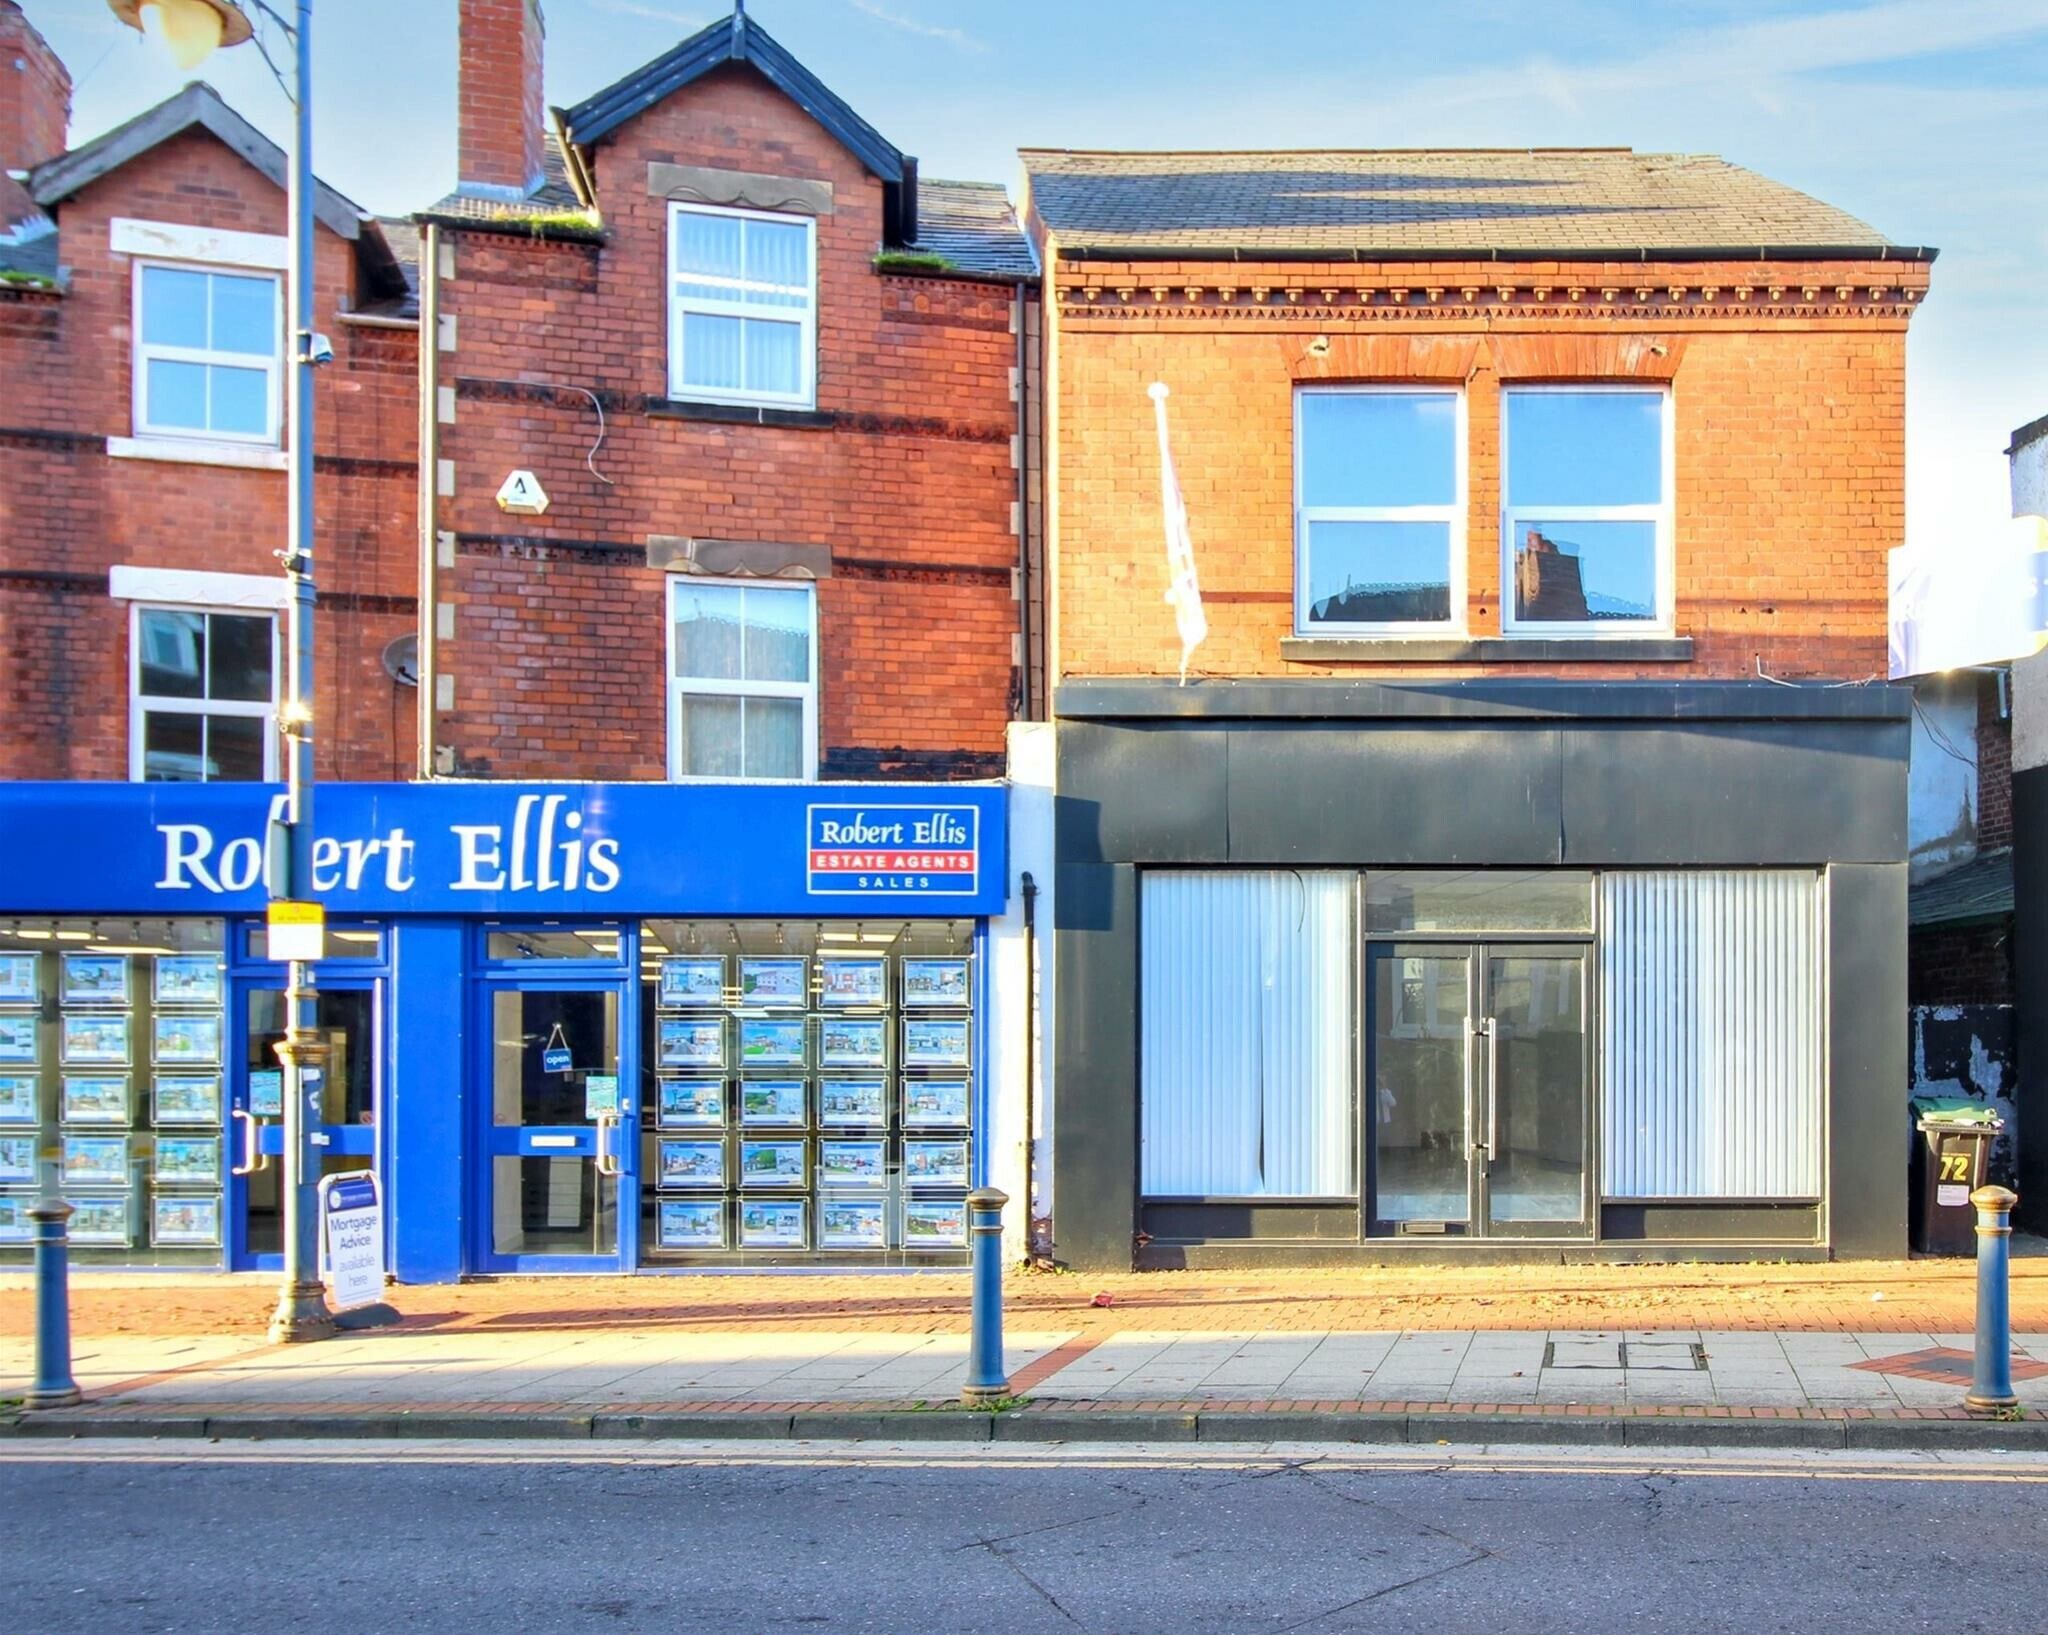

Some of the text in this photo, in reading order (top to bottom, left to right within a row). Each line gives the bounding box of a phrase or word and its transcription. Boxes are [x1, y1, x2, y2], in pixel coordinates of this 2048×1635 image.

[820, 812, 967, 844] Robert Ellis
[448, 795, 620, 892] Ellis
[816, 855, 970, 868] ESTATE AGENTS
[858, 877, 929, 888] SALES
[546, 1055, 569, 1065] open
[1939, 1156, 1968, 1180] 72
[331, 1216, 377, 1232] Mortgage
[339, 1234, 372, 1250] Advice
[339, 1255, 375, 1272] available
[348, 1274, 368, 1287] here
